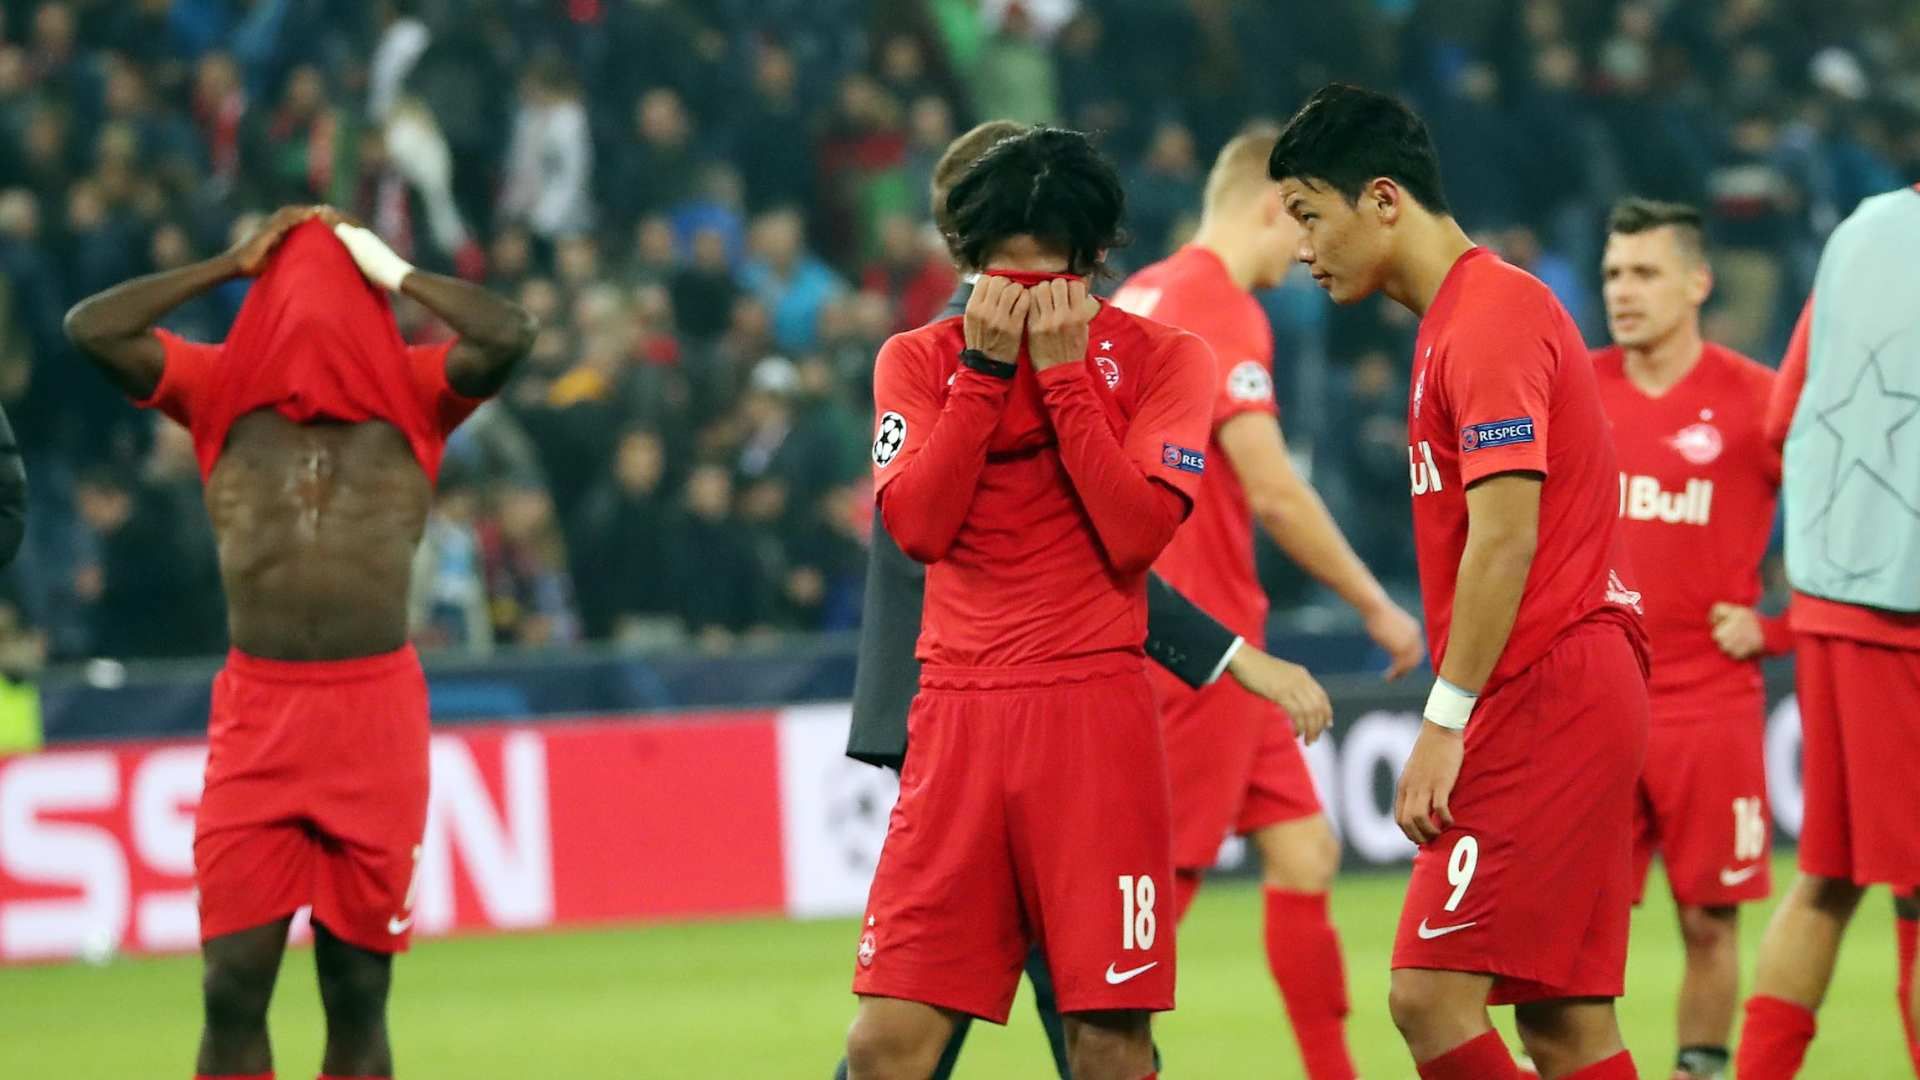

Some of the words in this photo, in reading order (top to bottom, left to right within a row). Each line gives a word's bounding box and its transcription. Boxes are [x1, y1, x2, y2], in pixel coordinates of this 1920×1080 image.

[1479, 424, 1533, 441] RESPECT
[1629, 475, 1714, 526] Bull
[1732, 795, 1765, 860] 16
[1447, 836, 1479, 912] 9
[1119, 875, 1156, 950] 18
